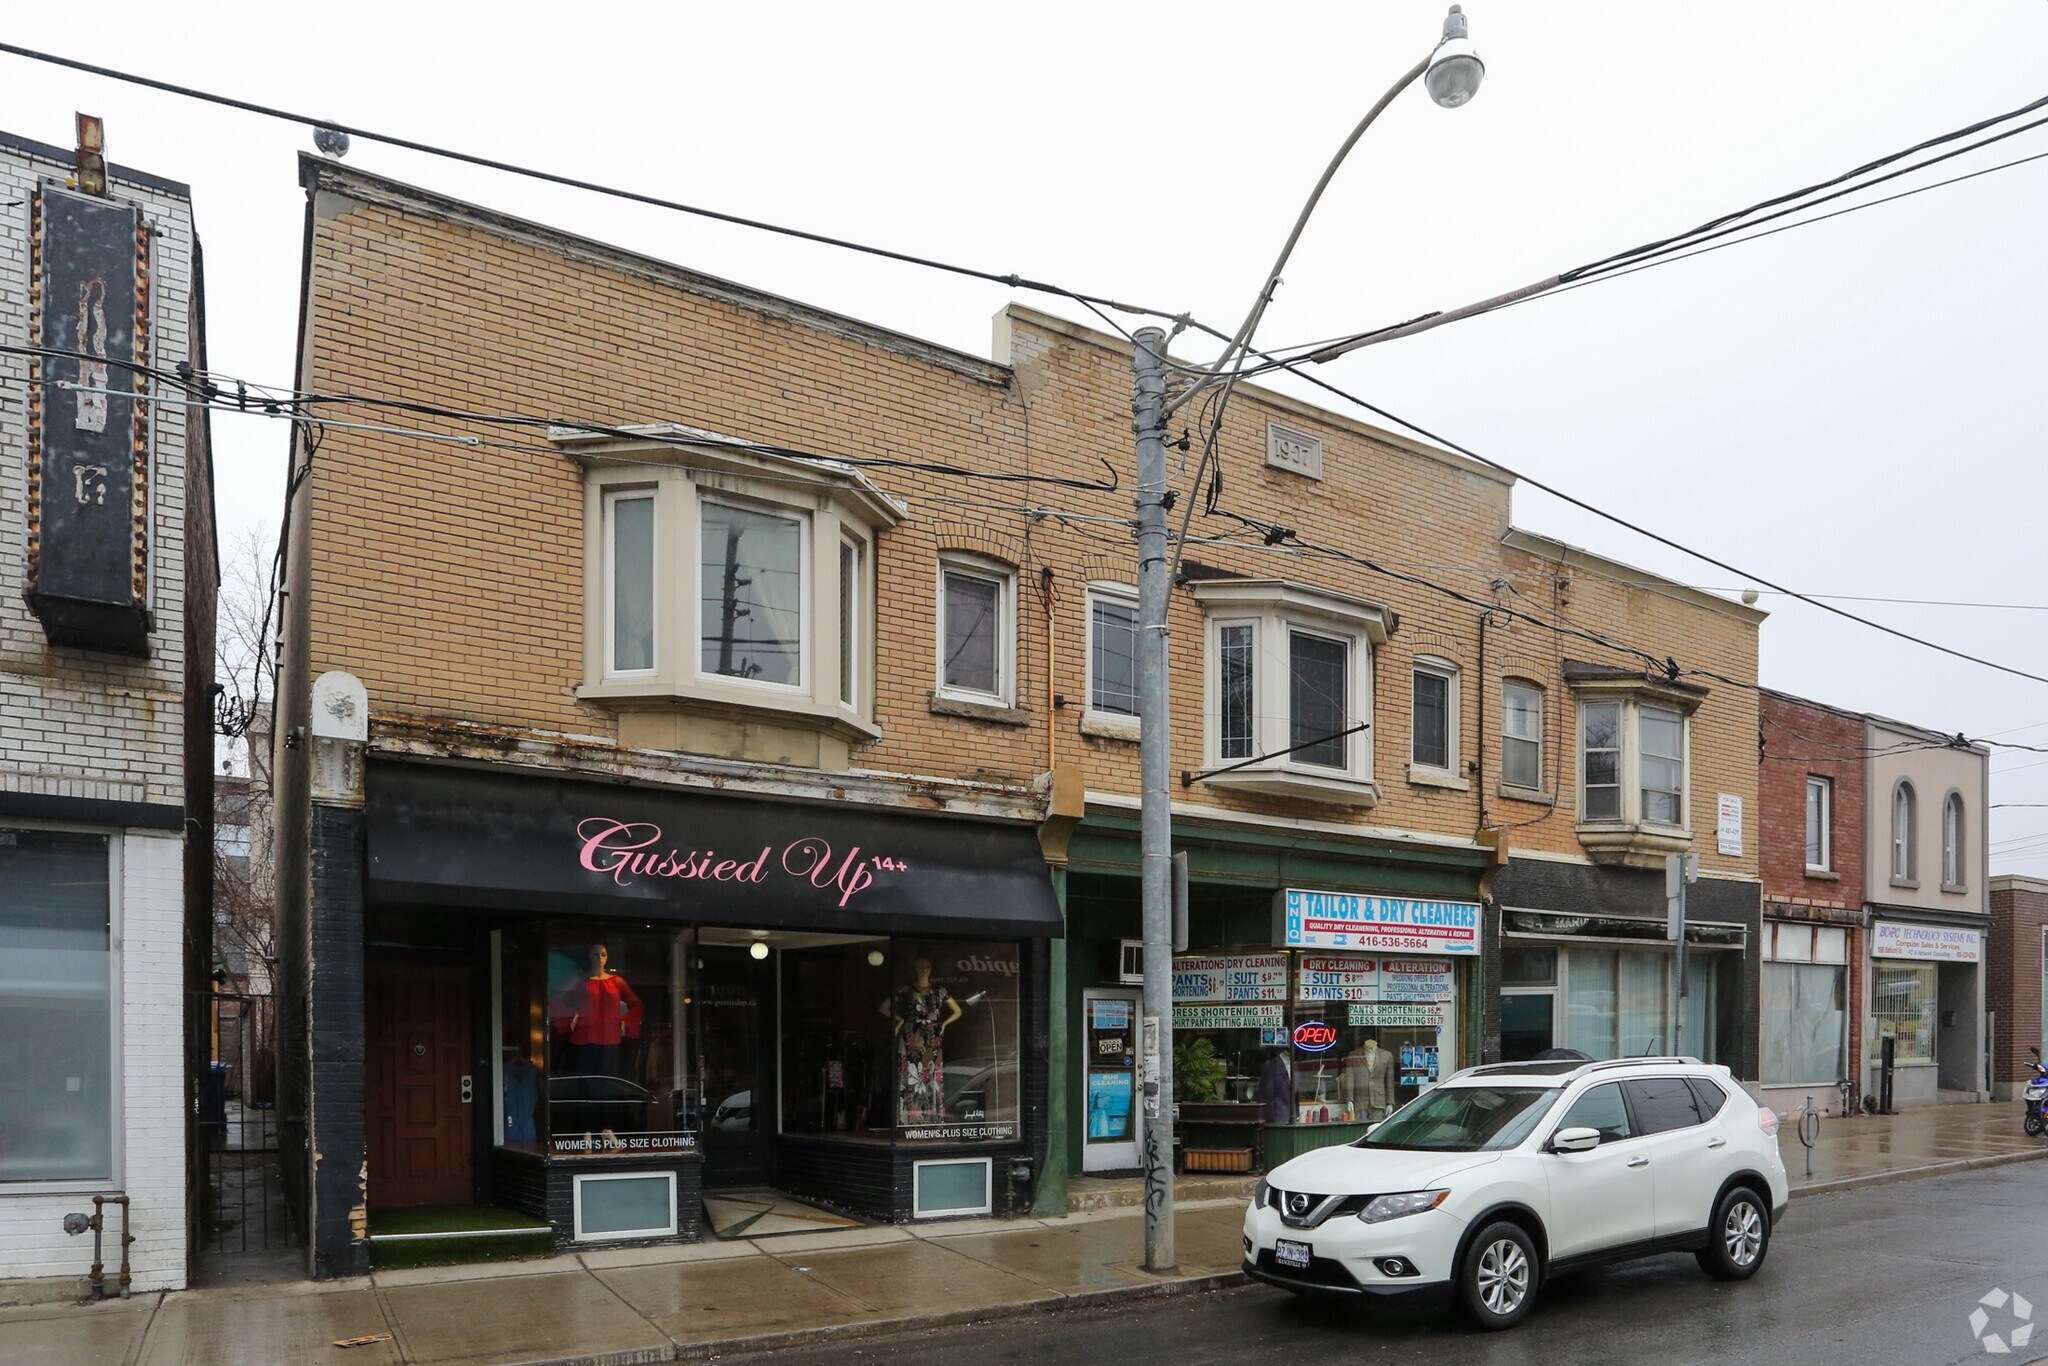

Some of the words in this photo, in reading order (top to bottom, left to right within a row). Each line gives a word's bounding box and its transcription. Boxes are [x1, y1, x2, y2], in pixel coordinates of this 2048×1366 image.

[577, 817, 772, 887] Gussied
[782, 837, 873, 907] Up
[871, 855, 909, 872] 14+
[1306, 892, 1360, 920] TAILOR
[1364, 896, 1375, 921] &
[1379, 897, 1410, 923] DRY
[1411, 901, 1476, 928] CLEANERS
[1288, 894, 1301, 941] UNIQ
[1309, 921, 1333, 931] QUALITY
[1333, 923, 1346, 931] DRY
[1380, 926, 1417, 935] PROFESSIONAL
[1418, 928, 1447, 937] ALTERATION
[1453, 930, 1470, 938] REPAIR
[1903, 928, 1940, 941] TECHNOLOGY
[1943, 931, 1965, 943] SYSTEMS
[1358, 936, 1428, 949] 416-536-5664
[1896, 940, 1920, 948] Computer
[1921, 941, 1934, 949] Sales
[1172, 959, 1225, 971] ALTERATIONS
[1227, 959, 1244, 969] DRY
[1245, 957, 1286, 968] CLEANING
[1309, 960, 1328, 970] DRY
[1328, 960, 1370, 972] CLEANING
[1388, 961, 1446, 973] ALTERATION
[1234, 972, 1259, 984] SUIT
[1312, 972, 1342, 985] SUIT
[1392, 974, 1413, 982] WEDDING
[1413, 974, 1428, 982] DRESS
[1434, 975, 1444, 983] SUIT
[1172, 985, 1209, 997] HORTENING
[1227, 987, 1233, 1000] 3
[1233, 987, 1259, 999] PANTS
[1304, 987, 1310, 999] 3
[1311, 987, 1343, 1000] PANTS
[1386, 983, 1418, 991] PROFESSIONAL
[1420, 984, 1449, 992] ALTERATIONS
[1172, 1008, 1199, 1017] DRESS
[1200, 1006, 1258, 1017] SHORTENING
[1349, 1005, 1374, 1014] PANTS
[1376, 1005, 1426, 1015] SHORTENING
[1214, 1017, 1241, 1027] FITTING
[1242, 1016, 1281, 1027] AVAILABLE
[1349, 1016, 1375, 1025] DRESS
[1376, 1016, 1426, 1025] SHORTENING
[1294, 1027, 1336, 1043] OPEN
[1099, 1043, 1122, 1053] OPEN
[905, 1129, 941, 1140] WOMEN'S
[942, 1128, 961, 1138] PLUS
[962, 1128, 978, 1137] SIZE
[979, 1126, 1013, 1136] CLOTHING
[555, 1139, 602, 1151] WOMEN'S
[603, 1138, 628, 1150] PLUS
[629, 1138, 650, 1149] SIZE
[651, 1136, 696, 1147] CLOTHING
